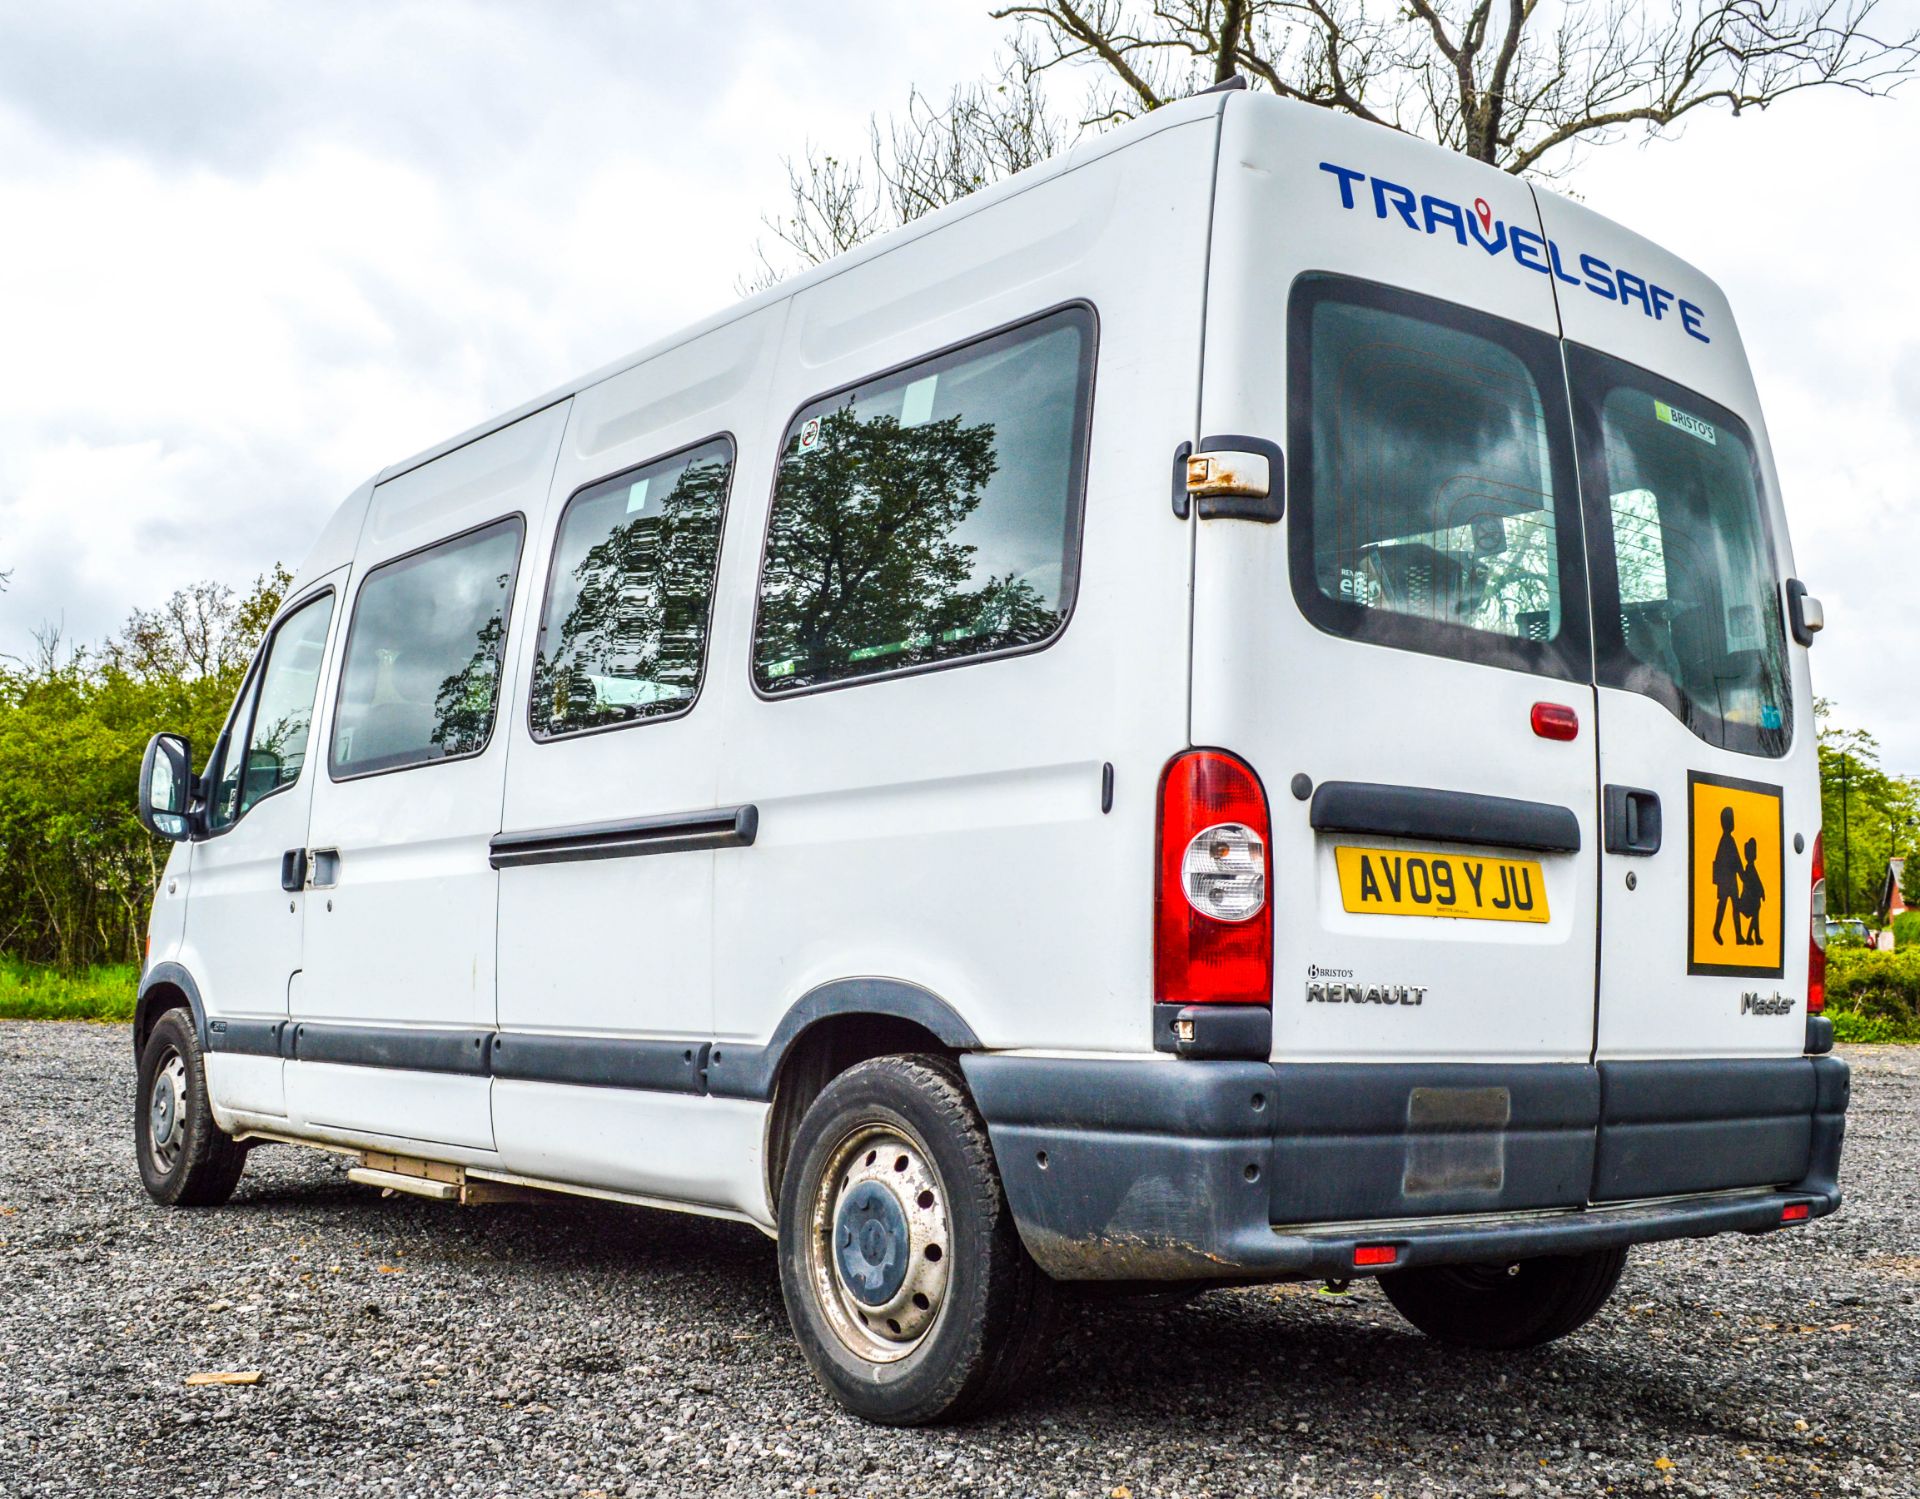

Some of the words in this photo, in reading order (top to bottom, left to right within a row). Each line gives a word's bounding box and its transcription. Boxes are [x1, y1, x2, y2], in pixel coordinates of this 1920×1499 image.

[1319, 162, 1710, 344] TRAVELSAFE
[1670, 408, 1714, 440] BRISTO'S
[1360, 855, 1456, 905] AV09
[1463, 862, 1534, 911] YJU
[1320, 968, 1354, 978] BRISTO'S
[1306, 982, 1428, 1005] RENAULT
[1741, 990, 1795, 1015] Master
